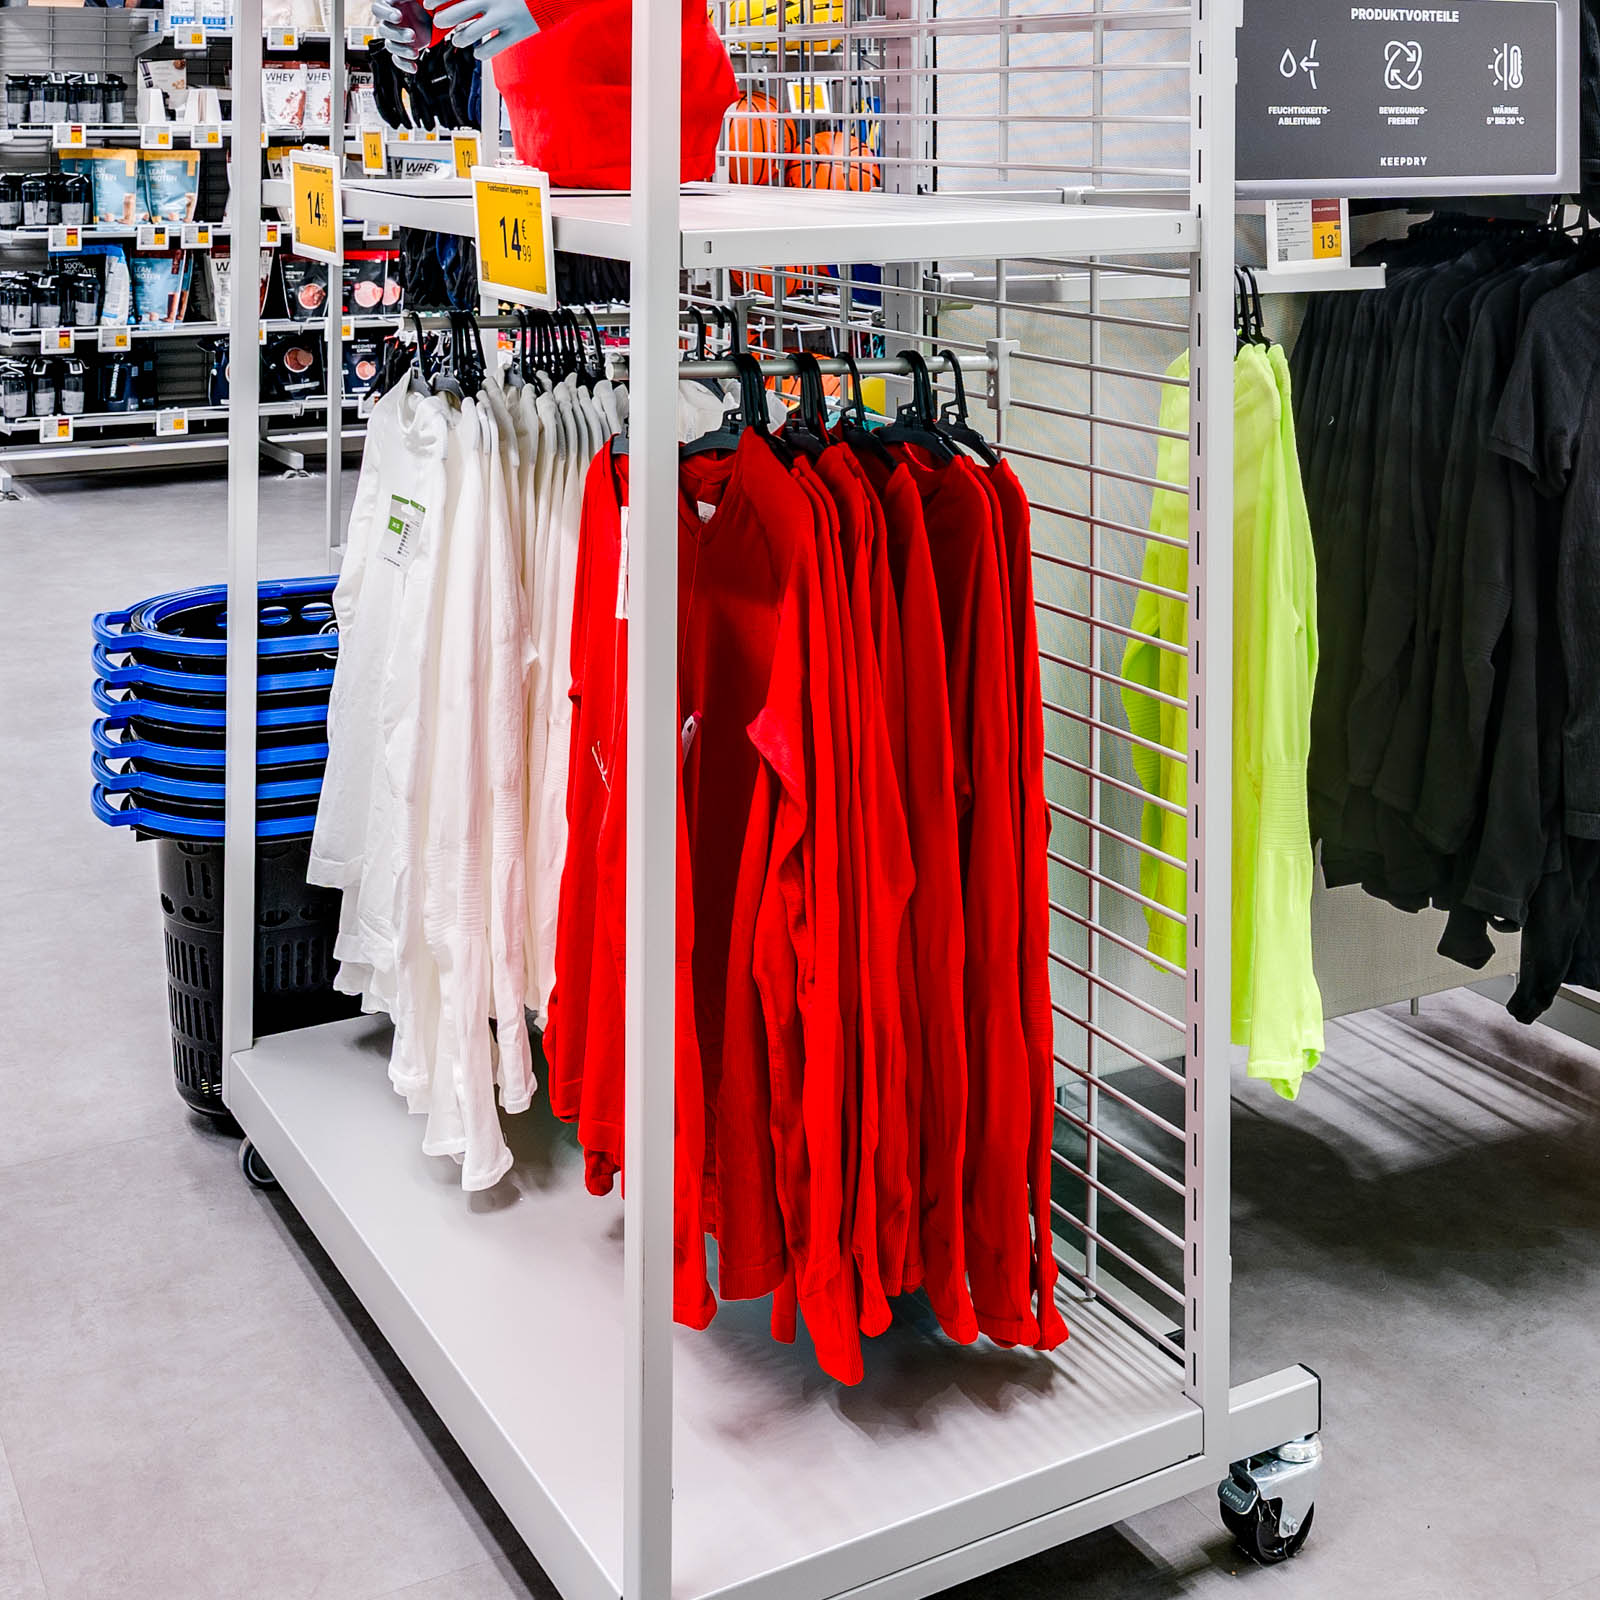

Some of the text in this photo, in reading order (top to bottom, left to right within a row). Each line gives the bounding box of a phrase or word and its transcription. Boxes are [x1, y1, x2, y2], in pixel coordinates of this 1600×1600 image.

[1351, 7, 1460, 24] PRODUKTVORTEILE
[265, 72, 295, 82] WHEY
[1268, 106, 1331, 115] FEUCHTIGKEITS-
[1278, 117, 1321, 126] ABLEITUNG
[1387, 117, 1419, 126] FREIHEIT
[1380, 156, 1427, 166] KEEPDRY
[406, 162, 440, 174] WHEY
[307, 190, 322, 226] 14
[499, 216, 522, 261] 14
[1319, 234, 1334, 249] 13
